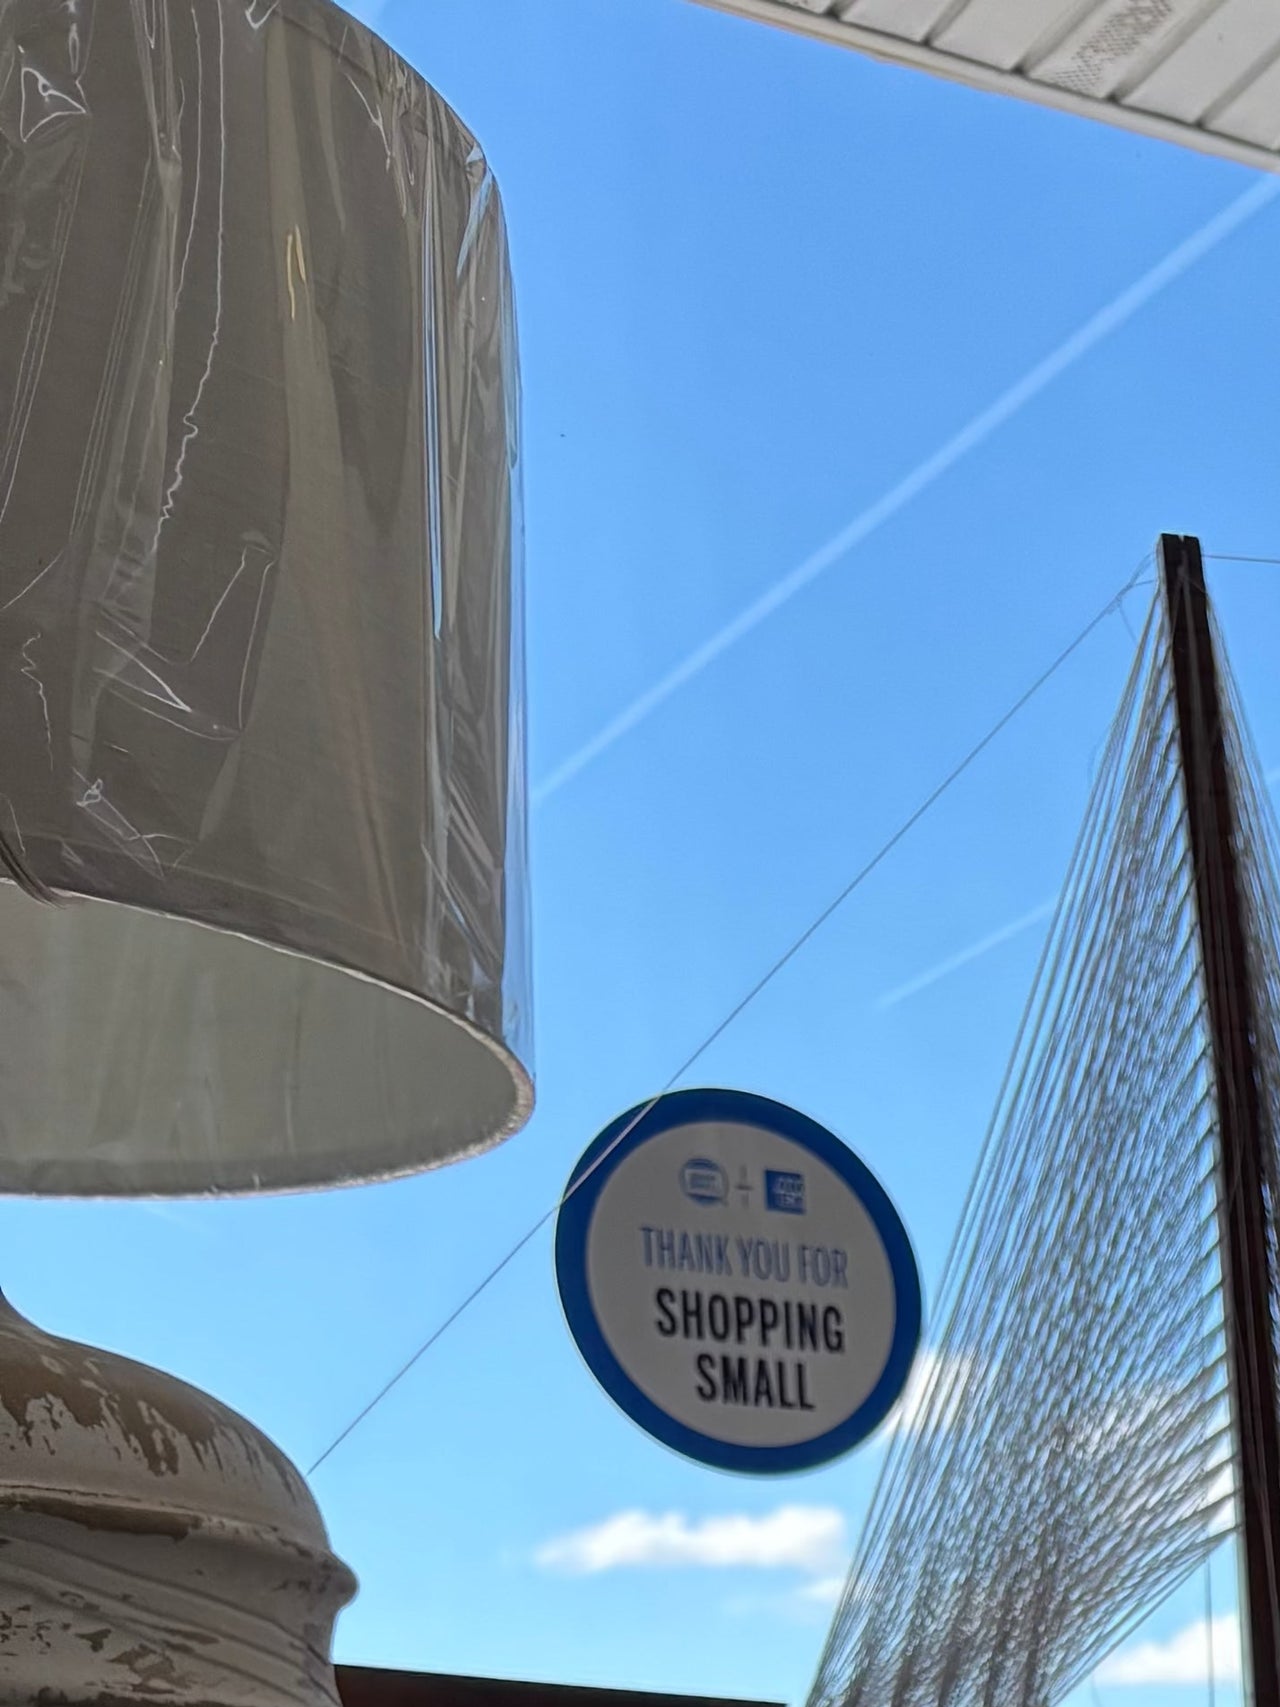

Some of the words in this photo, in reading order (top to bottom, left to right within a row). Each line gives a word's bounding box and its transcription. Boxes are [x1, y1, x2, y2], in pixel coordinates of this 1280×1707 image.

[639, 1225, 732, 1277] THANK
[736, 1236, 791, 1283] YOU
[798, 1246, 849, 1290] FOR
[655, 1286, 845, 1355] SHOPPING
[695, 1353, 816, 1412] SMALL
